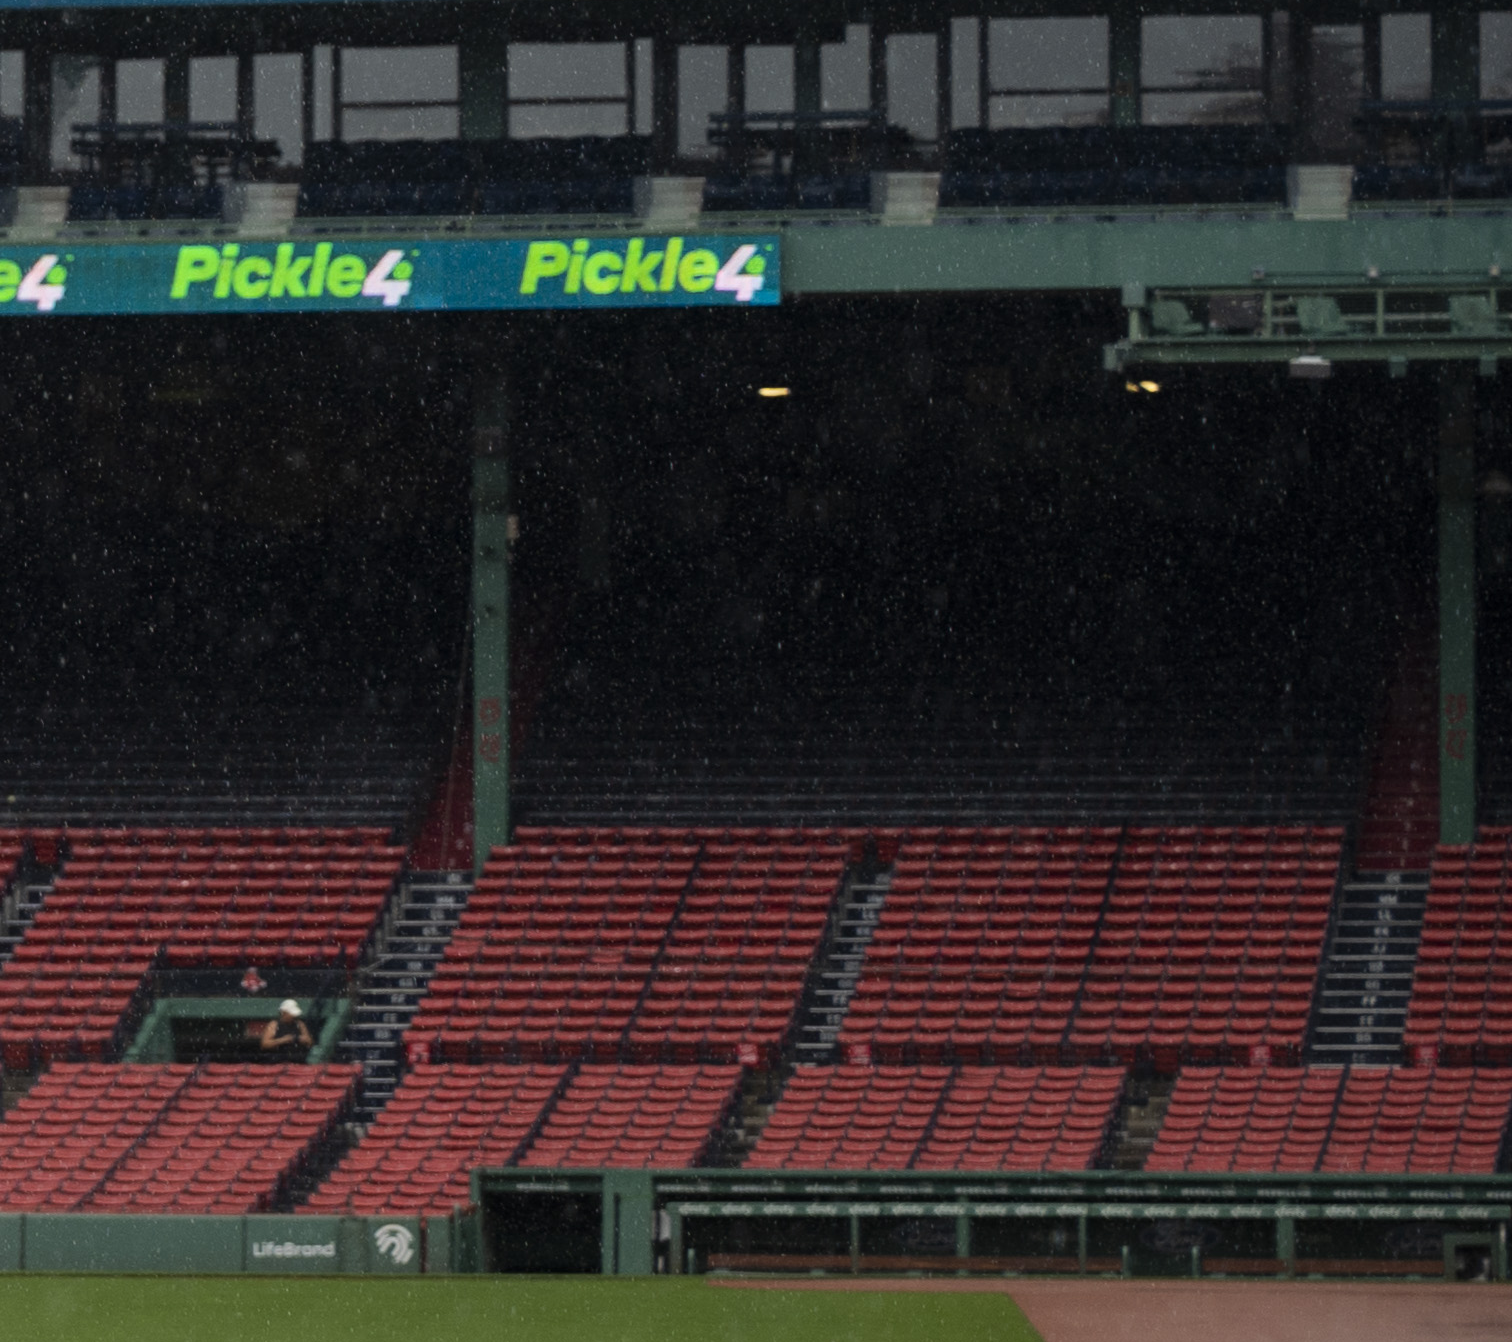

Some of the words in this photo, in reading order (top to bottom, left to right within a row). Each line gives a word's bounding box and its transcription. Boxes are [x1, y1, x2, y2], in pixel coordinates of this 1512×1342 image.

[170, 243, 413, 306] Pickle4
[520, 238, 764, 301] Pickle4
[252, 1241, 336, 1258] LifeBrand
